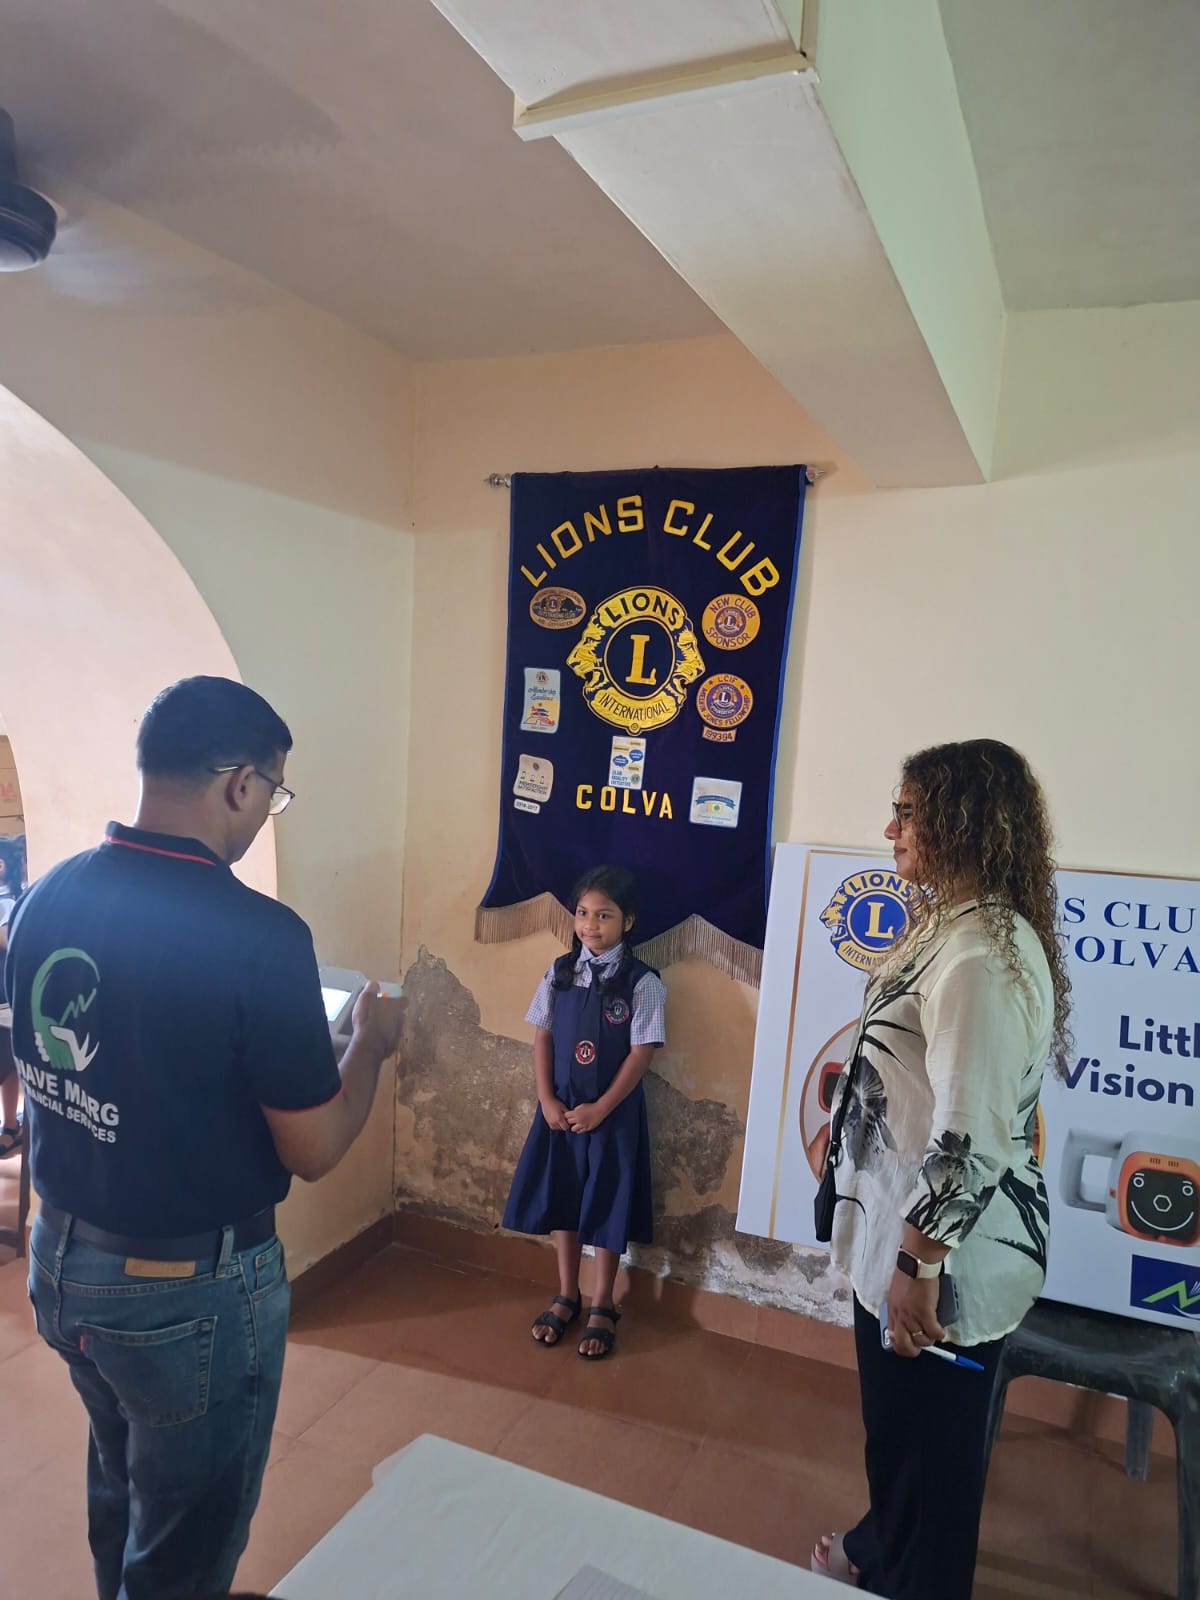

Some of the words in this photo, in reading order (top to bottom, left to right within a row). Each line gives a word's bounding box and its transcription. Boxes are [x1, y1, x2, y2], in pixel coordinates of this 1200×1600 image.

[520, 494, 644, 587] LIONS
[663, 499, 780, 596] CLUB
[604, 592, 680, 626] LIONS
[709, 597, 730, 613] NEW
[734, 598, 756, 618] CLUB
[706, 627, 751, 647] SPONSOR
[626, 634, 657, 685] L
[718, 675, 738, 683] LCIF
[599, 692, 670, 720] INTERNATIONAL
[703, 712, 723, 726] JONES
[576, 784, 673, 819] COLVA
[848, 873, 913, 898] LIONS
[865, 901, 894, 939] L
[1103, 901, 1197, 934] CLU
[1119, 1014, 1200, 1059] Littl
[1056, 1053, 1194, 1107] Vision
[64, 1079, 120, 1127] MARG
